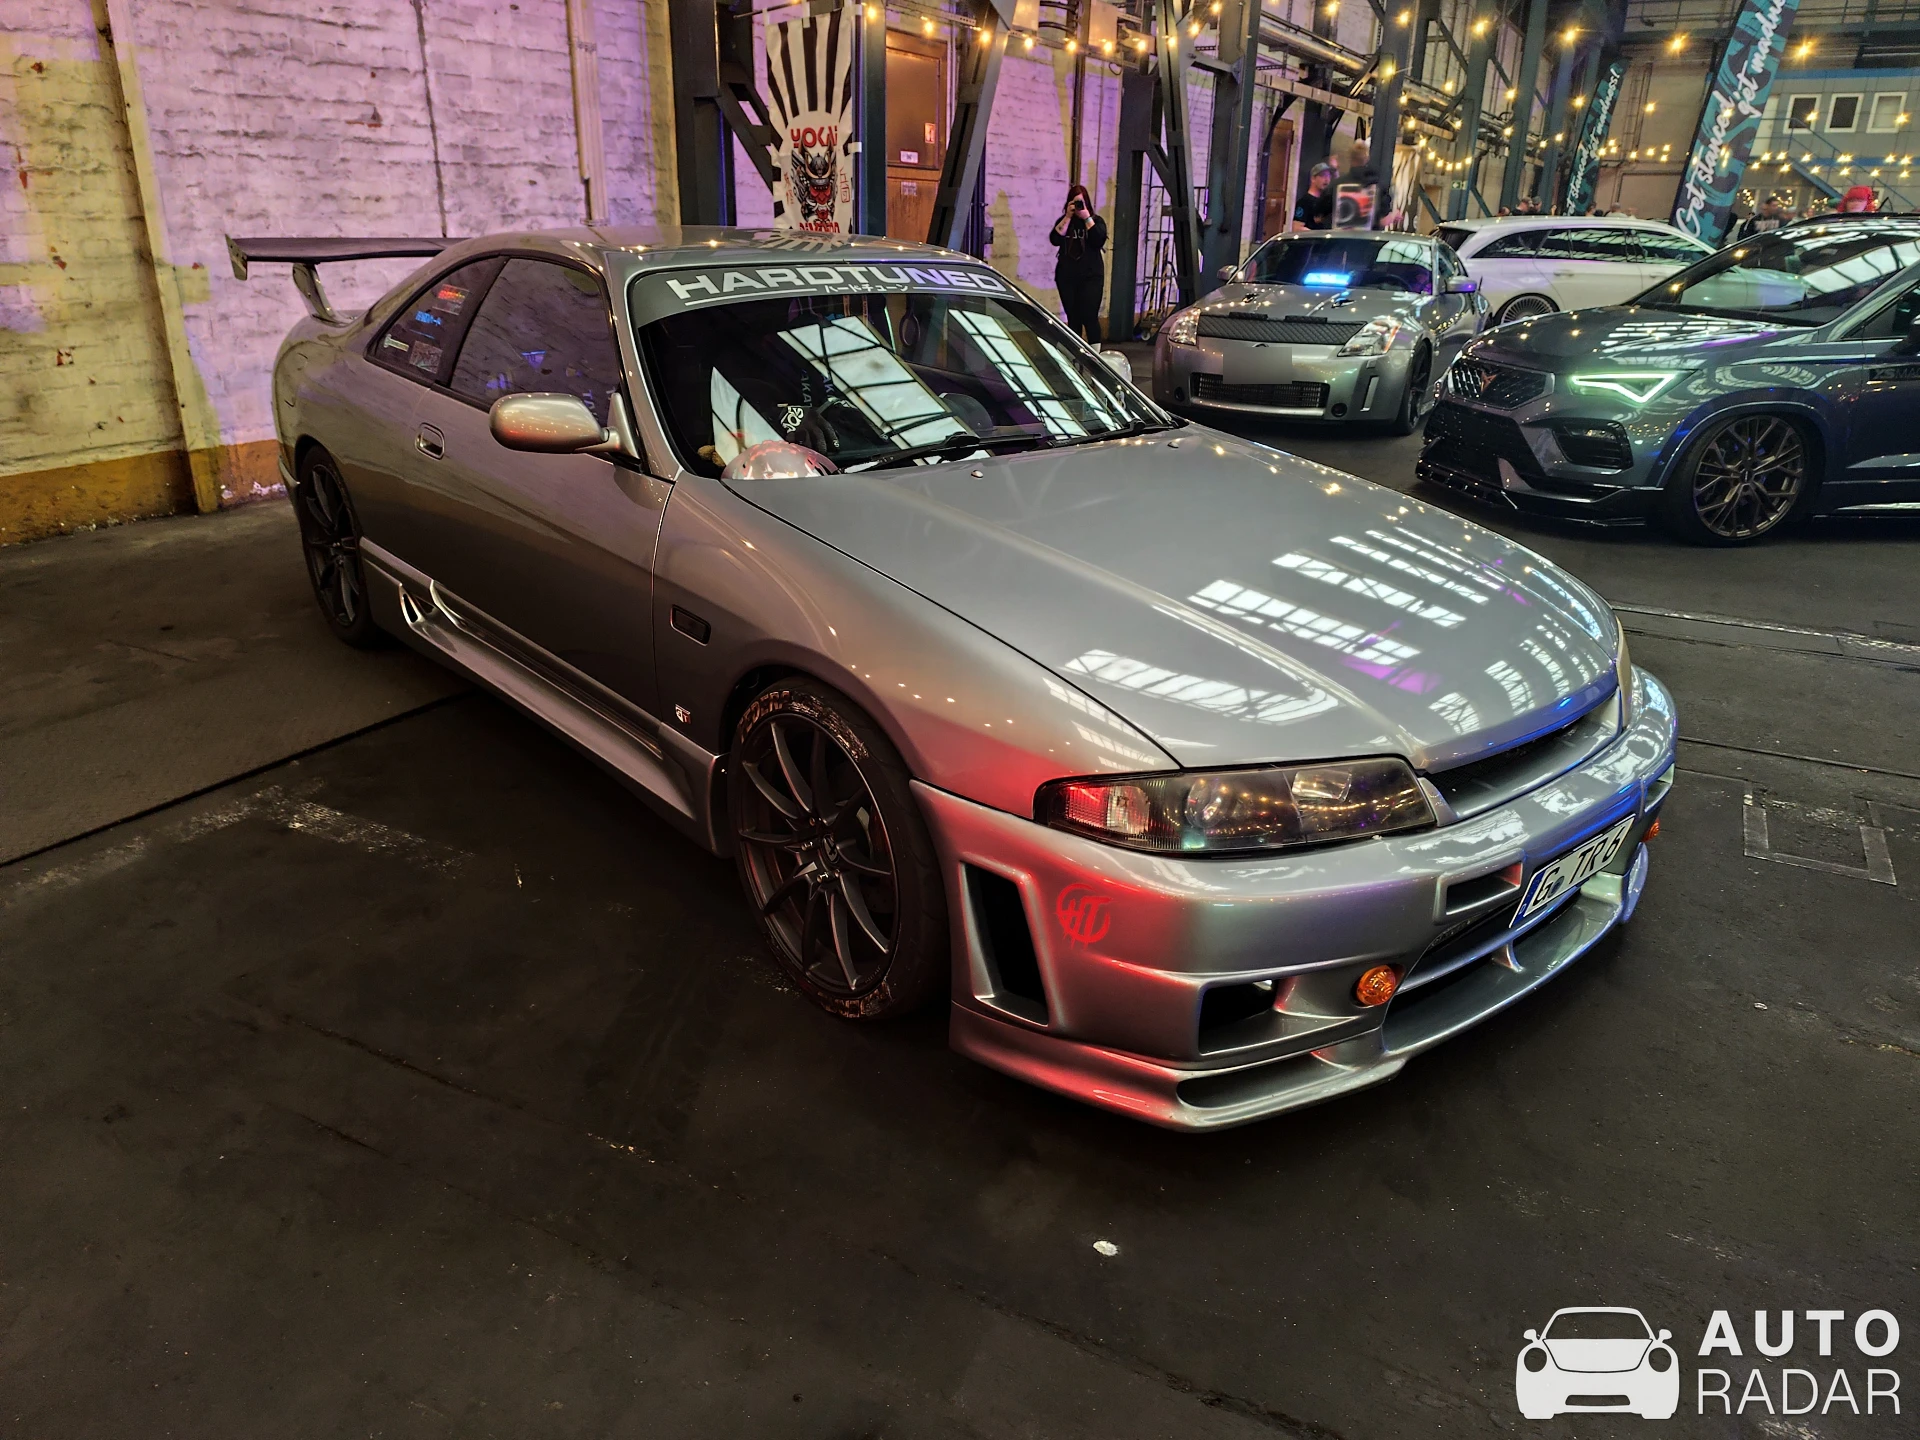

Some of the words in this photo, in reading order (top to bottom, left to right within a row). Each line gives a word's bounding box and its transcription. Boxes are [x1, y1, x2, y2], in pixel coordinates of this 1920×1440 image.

[1675, 145, 1707, 238] Get
[1737, 60, 1762, 118] get
[665, 265, 1007, 300] HARDTUNED
[824, 283, 908, 294] ハードチューン
[1532, 866, 1560, 907] G
